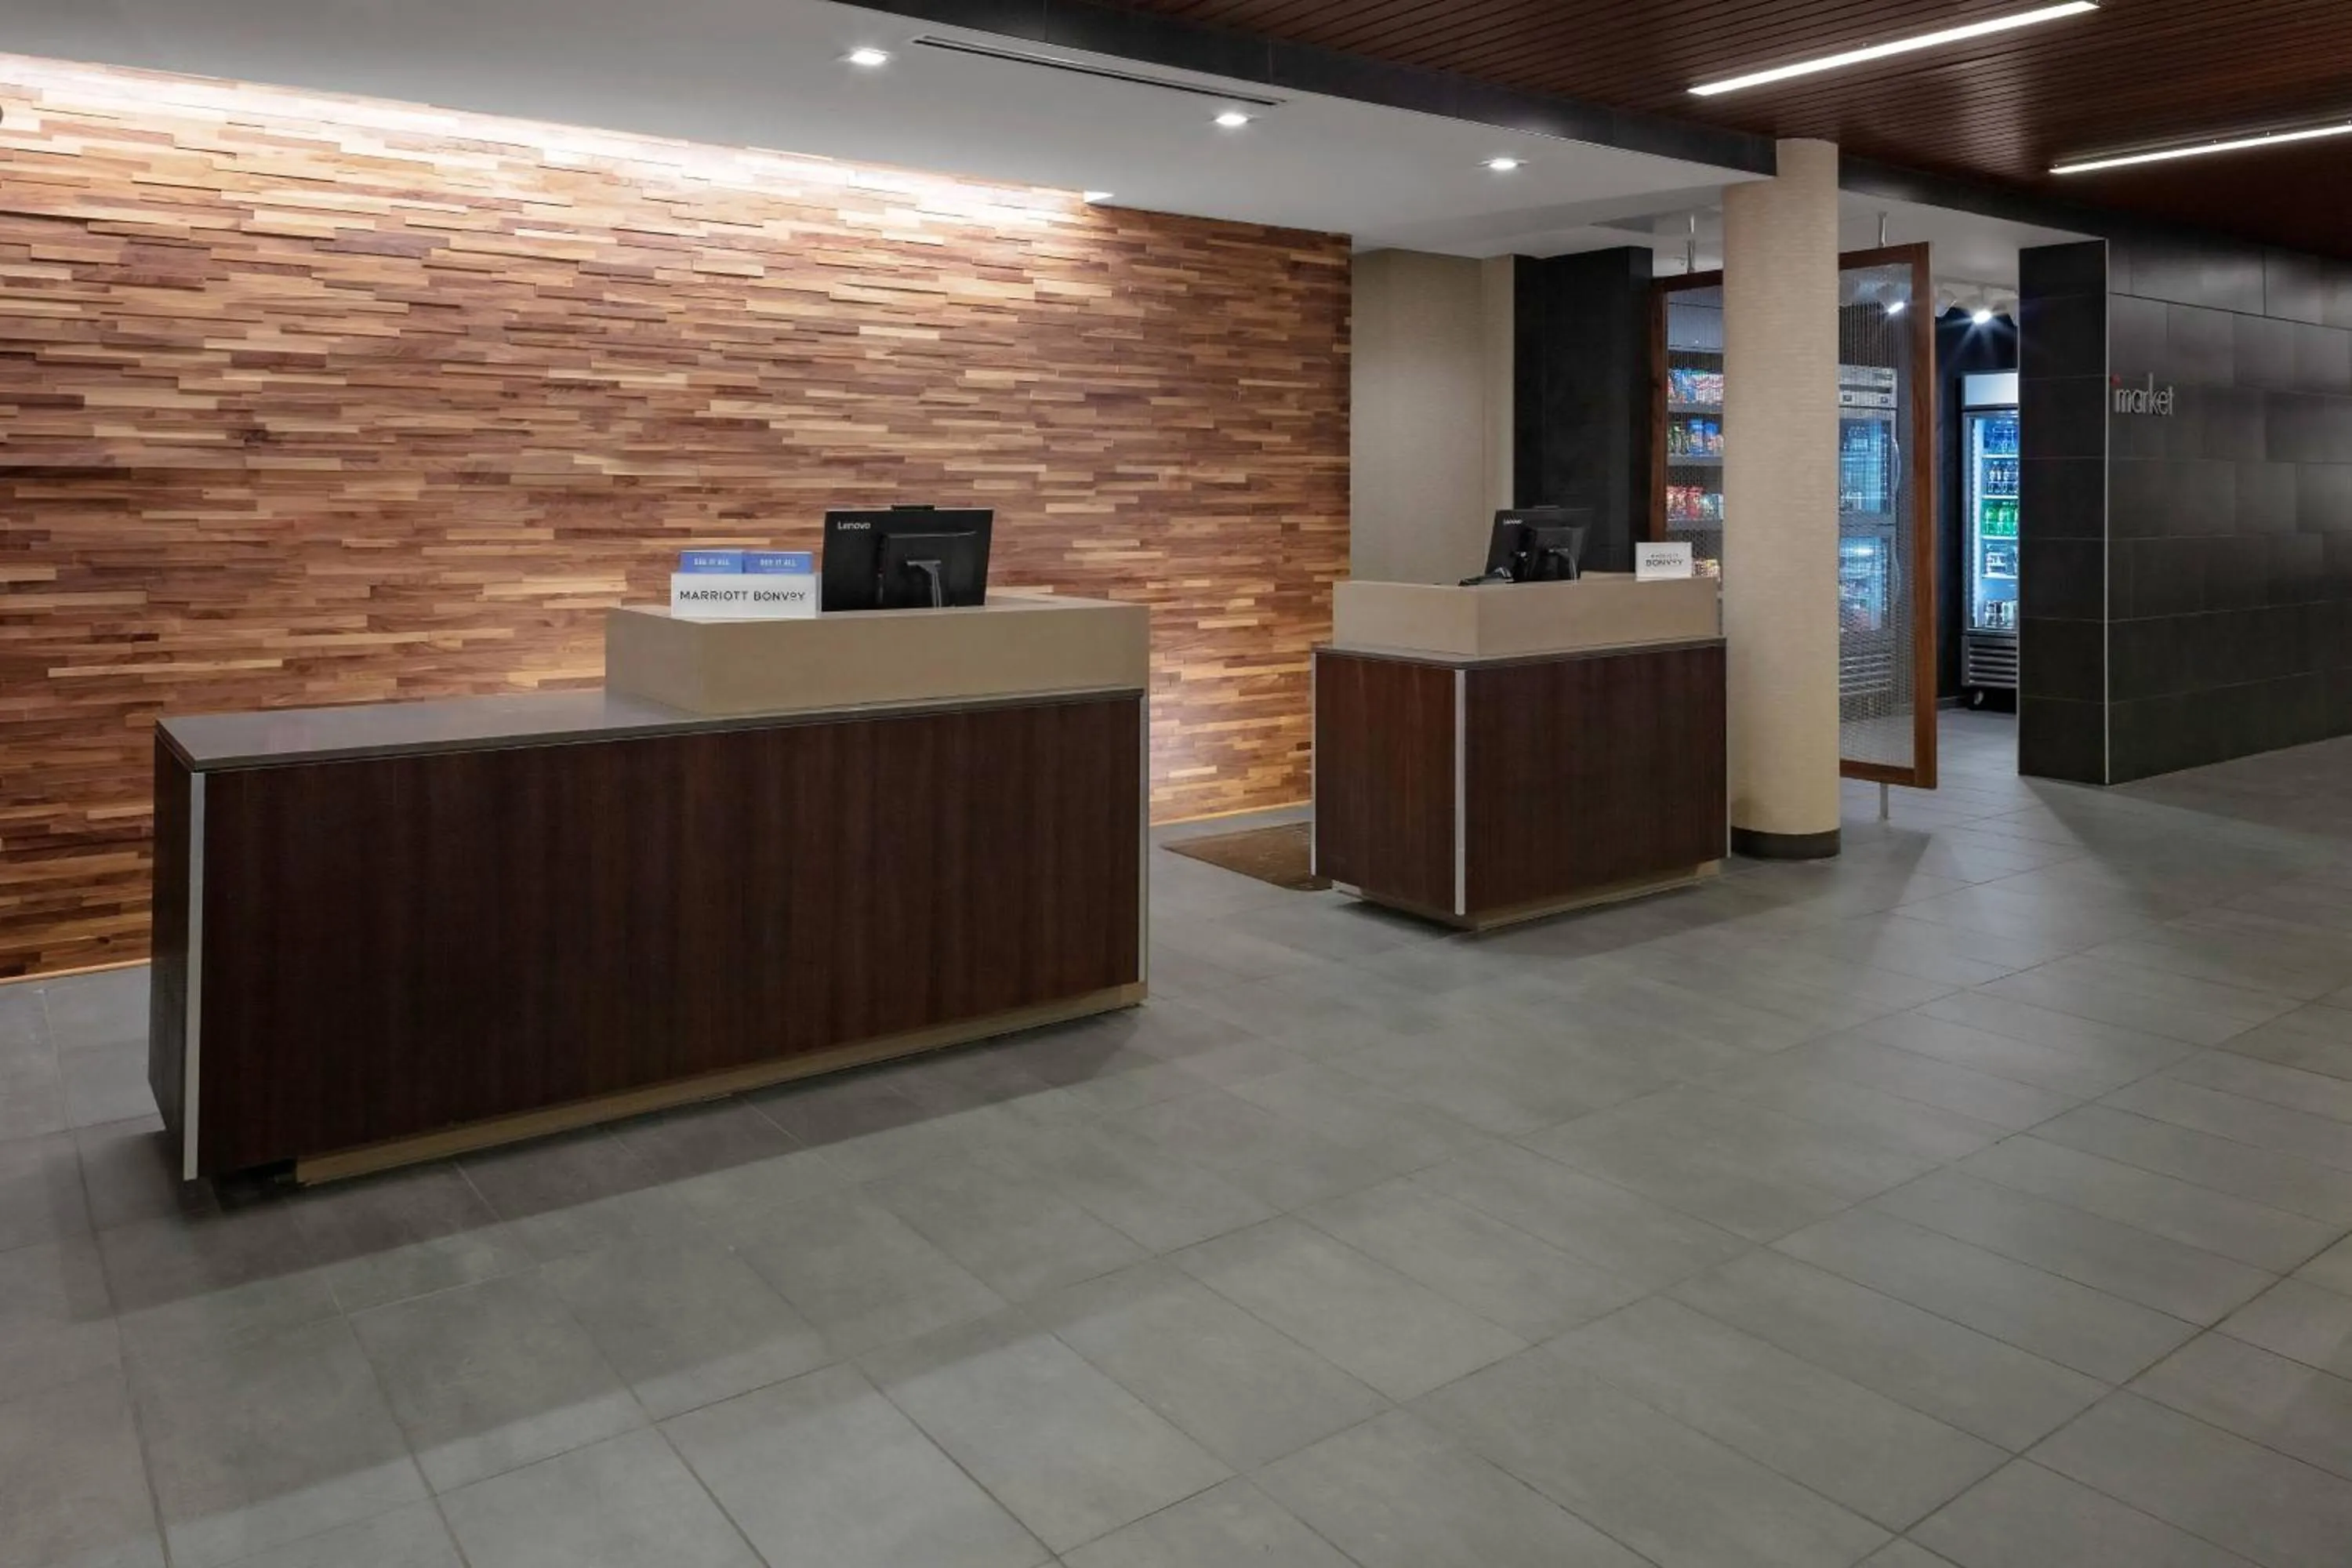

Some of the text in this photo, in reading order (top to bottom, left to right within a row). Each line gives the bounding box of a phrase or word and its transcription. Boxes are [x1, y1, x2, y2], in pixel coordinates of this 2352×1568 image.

[2115, 372, 2174, 415] market
[837, 521, 871, 531] Lenovo
[680, 590, 748, 601] MARRIOTT
